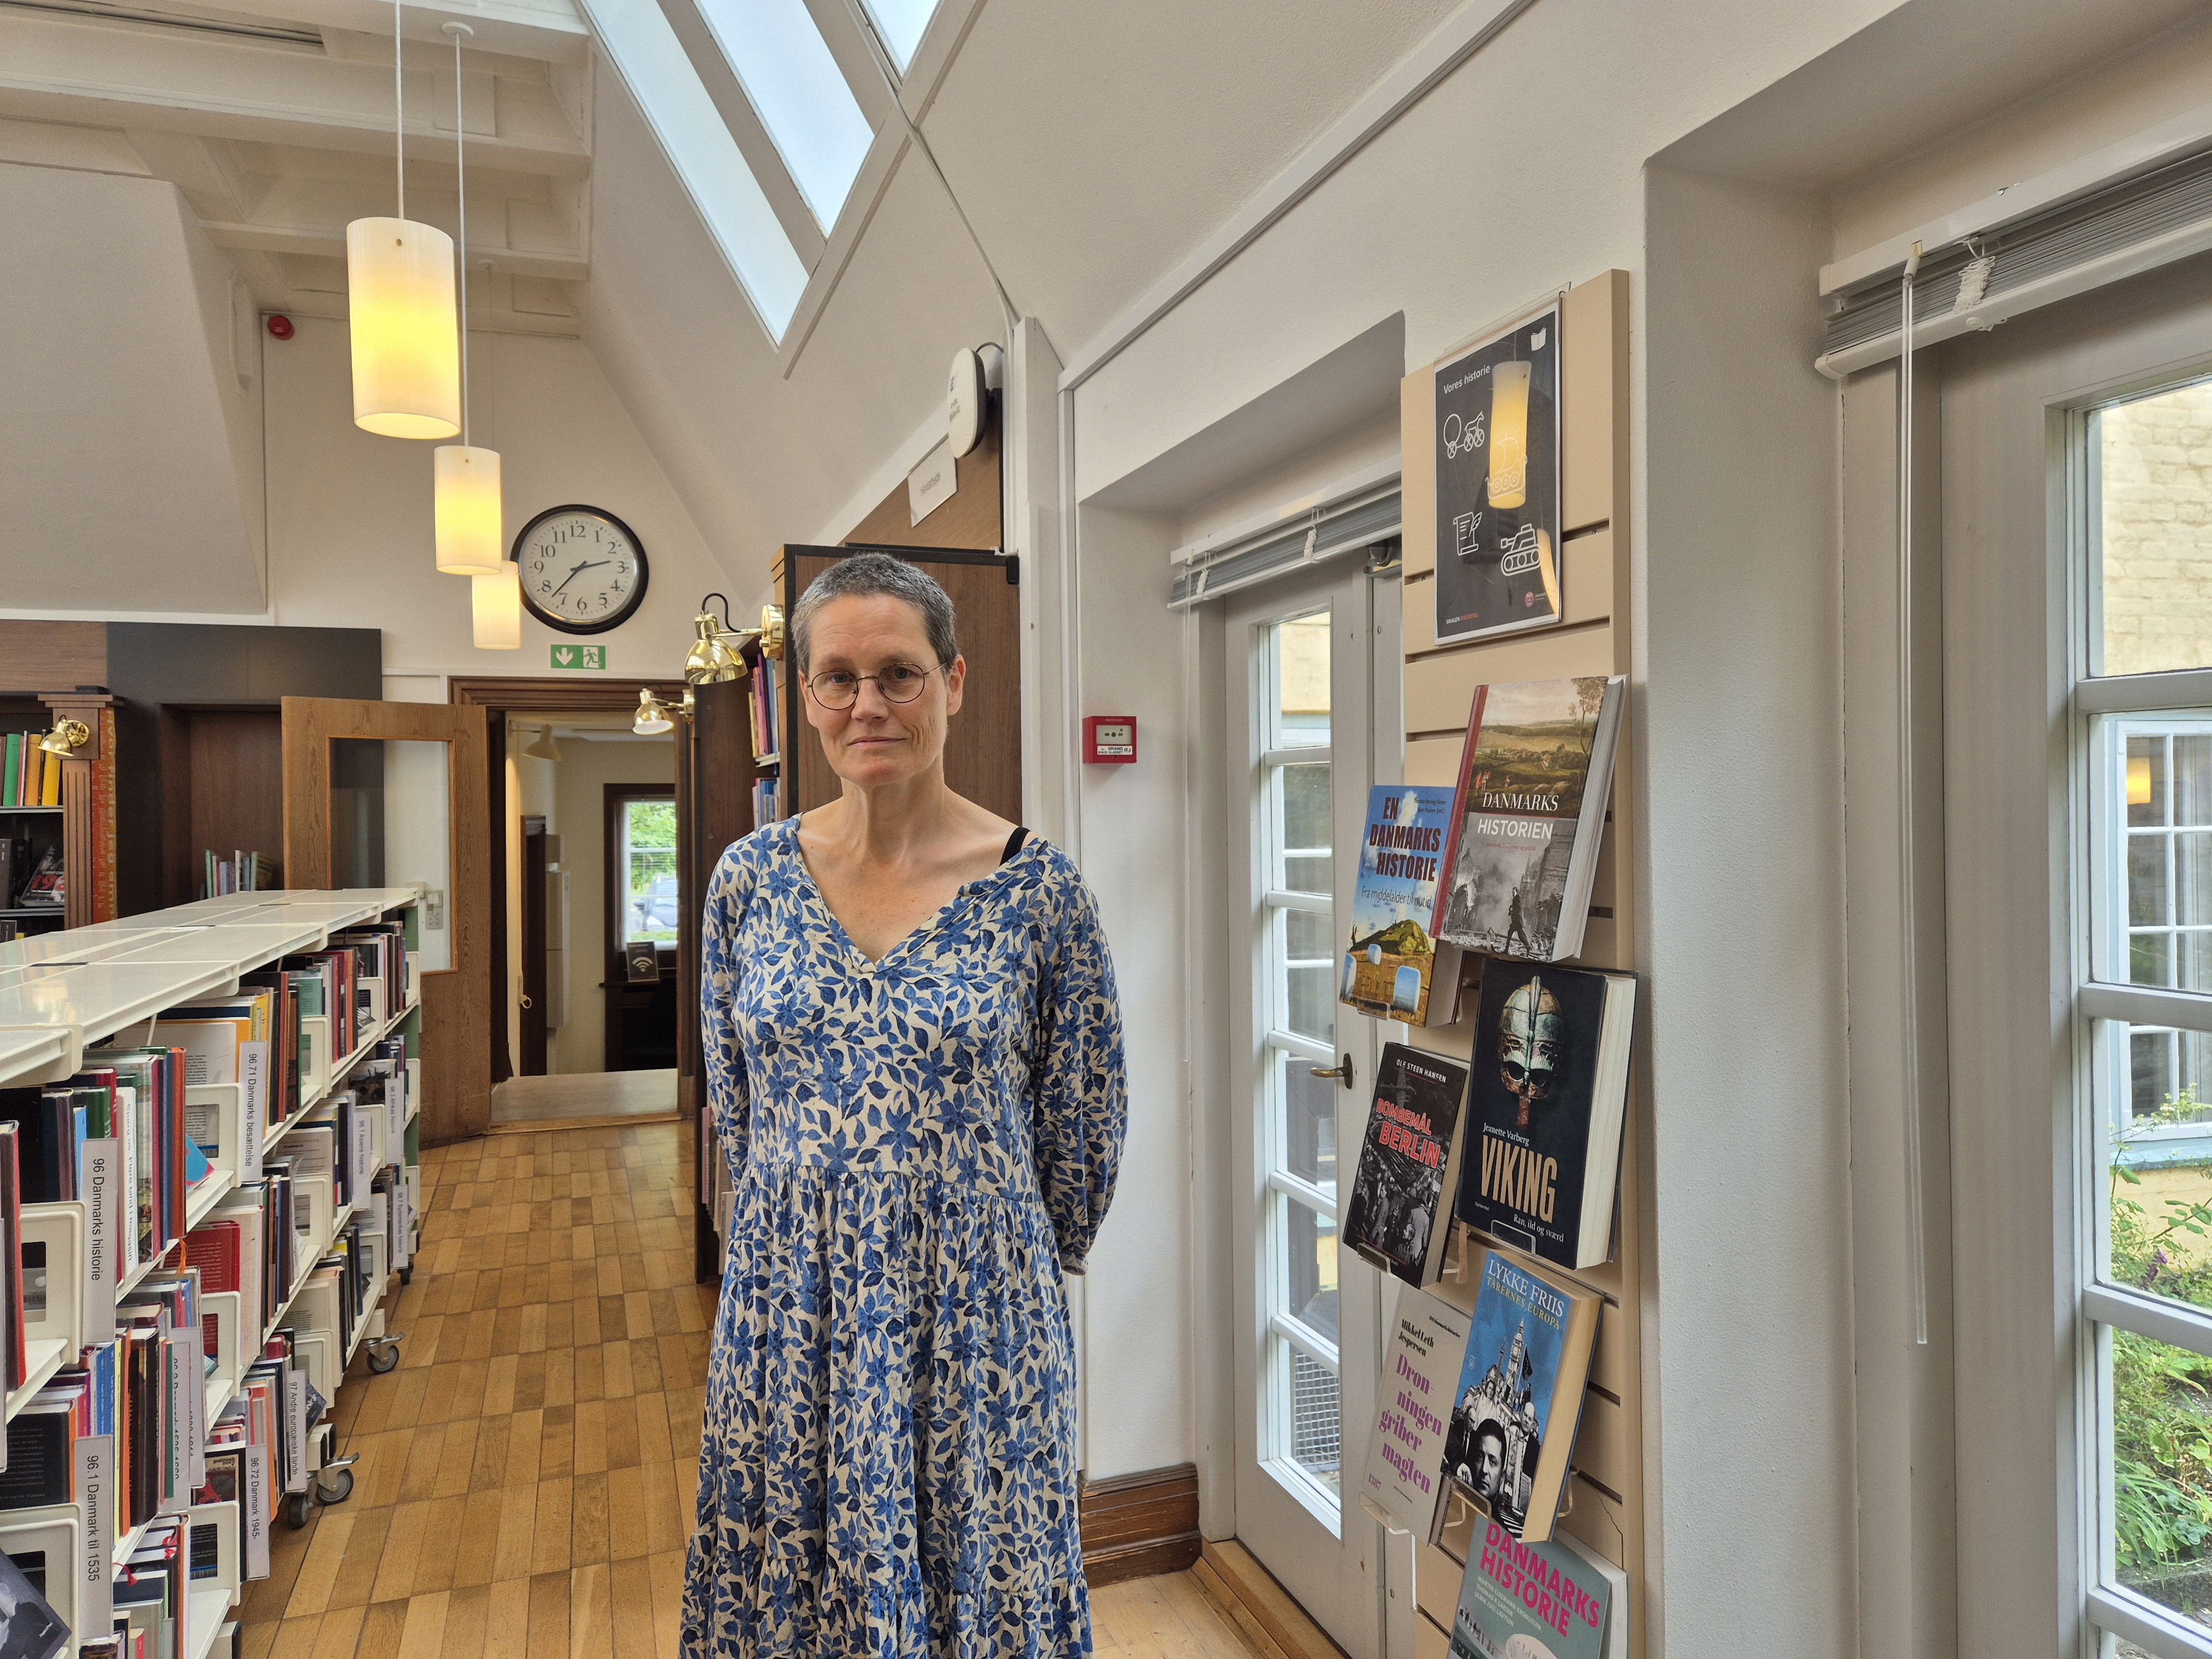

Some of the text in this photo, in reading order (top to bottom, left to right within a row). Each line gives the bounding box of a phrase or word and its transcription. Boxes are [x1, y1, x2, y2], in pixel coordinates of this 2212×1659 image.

[1443, 365, 1490, 394] Vores historie
[554, 530, 567, 544] 11
[570, 525, 586, 538] 12
[594, 530, 601, 542] 1
[540, 545, 556, 558] 10
[607, 541, 617, 554] 2
[534, 561, 544, 574] 9
[617, 561, 625, 573] 3
[541, 580, 552, 592] 8
[610, 579, 620, 592] 4
[559, 593, 568, 605] 7
[577, 597, 587, 611] 6
[599, 593, 607, 606] 5
[1383, 797, 1400, 820] EN
[1482, 792, 1559, 811] DANMARKS
[1369, 823, 1441, 852] DANMARKS
[1477, 818, 1553, 839] HISTORIEN
[1376, 852, 1437, 882] HISTORIE
[1361, 885, 1370, 899] Fra
[1370, 888, 1406, 904] middelalder
[1414, 895, 1432, 909] nutid
[1396, 1059, 1447, 1083] OLE STEEN HANSEN
[245, 1053, 257, 1166] 96.71 Danmarks besættelse
[1375, 1098, 1432, 1135] BOMBEMÅL
[1379, 1120, 1441, 1169] BERLIN
[1483, 1123, 1530, 1147] Jeanette Varberg
[1481, 1134, 1558, 1224] VIKING
[1474, 1201, 1490, 1211] Gyldendal
[91, 1158, 105, 1281] 96 Danmarks historie
[1513, 1214, 1527, 1229] Ran,
[1537, 1225, 1545, 1237] og
[1545, 1229, 1564, 1243] sværd
[1488, 1259, 1564, 1317] LYKKE FRIIS
[1527, 1302, 1560, 1330] EUROPA
[1398, 1331, 1426, 1357] Jespersen
[1401, 1318, 1434, 1348] Mikkel Leth
[290, 1382, 298, 1390] 97
[1396, 1353, 1434, 1395] Dron-
[1396, 1390, 1442, 1437] ningen
[1379, 1409, 1422, 1452] griber
[1382, 1442, 1431, 1494] magten
[1368, 1473, 1382, 1490] 1387
[251, 1481, 259, 1515] Danmark
[87, 1455, 100, 1582] 96.1 Danmark til 1535
[1485, 1523, 1600, 1627] DANMARKS
[1474, 1591, 1486, 1604] ULRIK
[1486, 1601, 1496, 1613] JUEL
[1477, 1583, 1493, 1601] THOMAS
[1498, 1601, 1513, 1618] LARSEN
[1478, 1576, 1541, 1631] MARTIN CLEEMANN RASMUSSEN
[1480, 1546, 1571, 1638] HISTORIE
